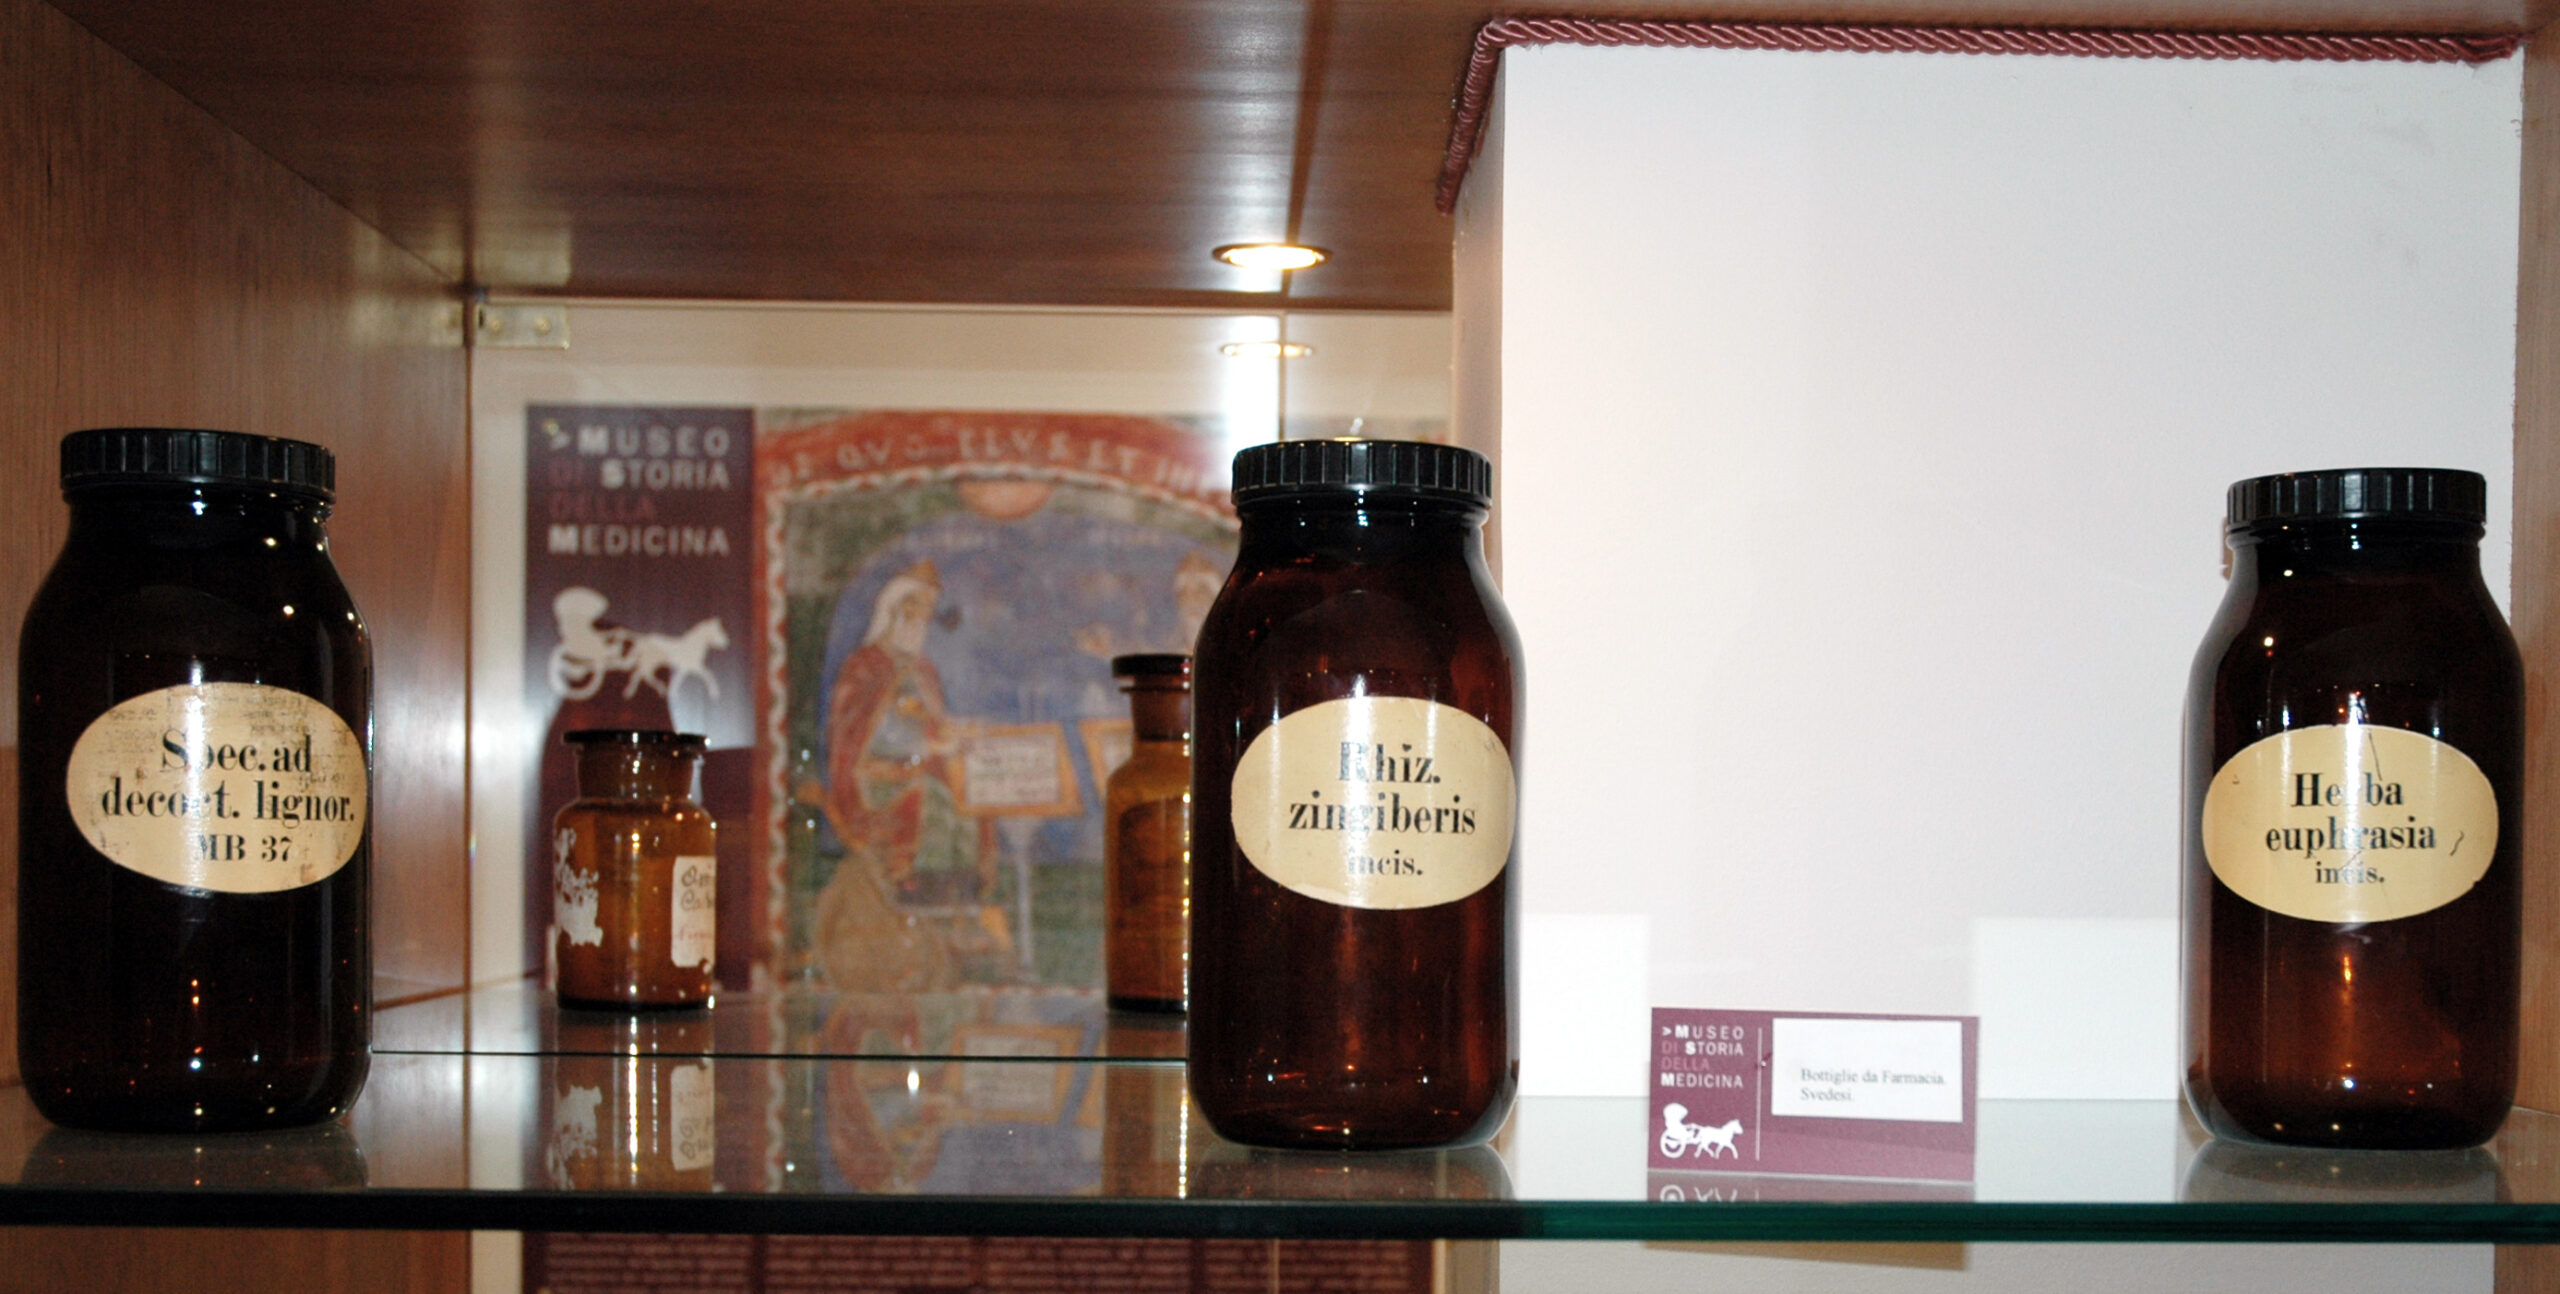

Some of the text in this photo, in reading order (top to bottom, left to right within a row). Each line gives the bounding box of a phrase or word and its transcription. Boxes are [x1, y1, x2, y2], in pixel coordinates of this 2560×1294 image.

[578, 425, 730, 457] MUSEO
[602, 458, 730, 490] STORIA
[549, 524, 731, 557] MEDICINA
[1338, 741, 1441, 784] Rhiz.
[253, 779, 355, 829] lignor.
[261, 835, 294, 862] 37
[2265, 815, 2437, 859] euphrasia
[1675, 1025, 1744, 1040] MUSEO
[1662, 1041, 1744, 1056] DI STORIA
[1661, 1056, 1710, 1072] DELLA
[1800, 1068, 1858, 1086] Bottiglie
[1862, 1070, 1879, 1083] da
[1661, 1072, 1744, 1089] MEDICINA
